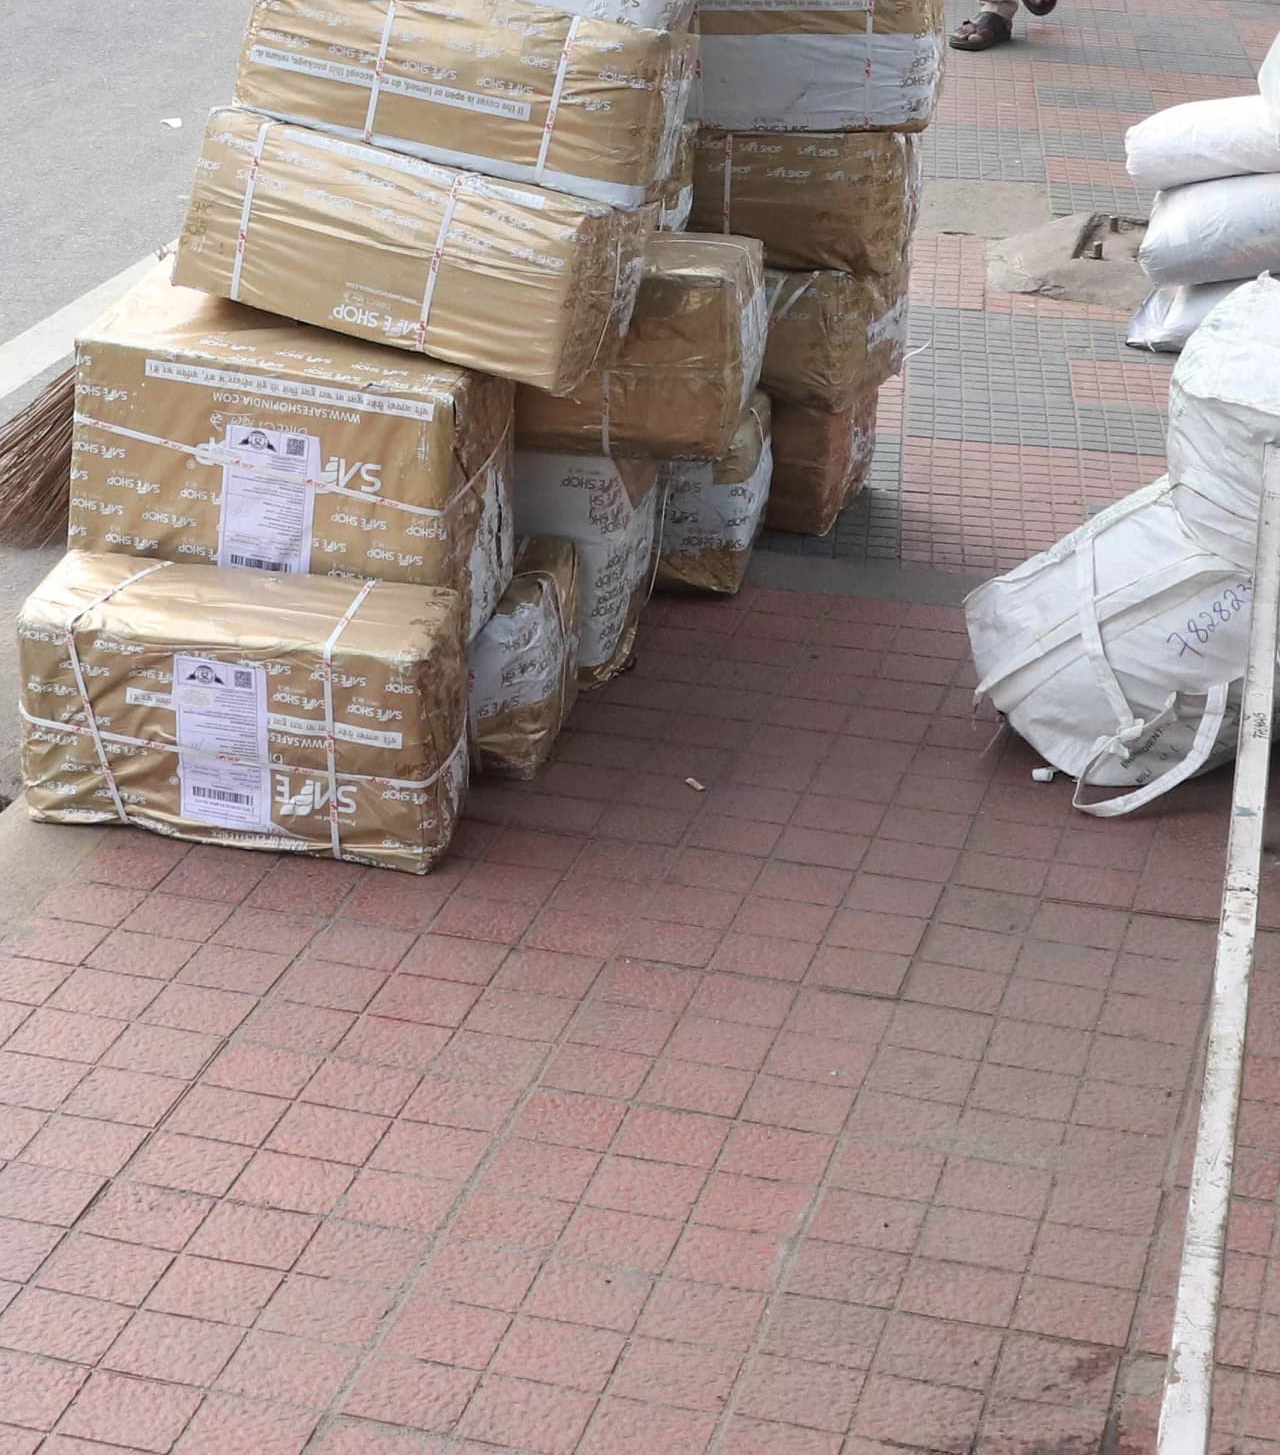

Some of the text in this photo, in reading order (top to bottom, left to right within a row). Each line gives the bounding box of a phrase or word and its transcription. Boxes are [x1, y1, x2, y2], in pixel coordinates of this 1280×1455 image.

[330, 65, 346, 79] this
[390, 78, 402, 90] do
[445, 88, 465, 103] open
[476, 96, 498, 111] cover
[500, 101, 515, 114] the
[332, 304, 378, 326] SHOP
[101, 389, 128, 402] SAFE
[212, 391, 361, 424] WWW.SAFESHOPINDIA.COM
[100, 445, 126, 459] SAFE
[106, 474, 161, 494] SAFE SHOP
[561, 476, 592, 487] SHOP
[179, 486, 207, 502] SHOP
[98, 501, 124, 515] SAFE
[141, 509, 197, 528] SAFE SHOP
[330, 511, 387, 531] SAFE SHOP
[104, 530, 159, 551] SAFE SHOP
[178, 542, 207, 557] SHOP
[366, 547, 423, 567] SAFE SHOP
[272, 691, 326, 710] SAFE SHOP
[346, 702, 403, 721] SAFE SHOP
[274, 773, 358, 816] SAFE
